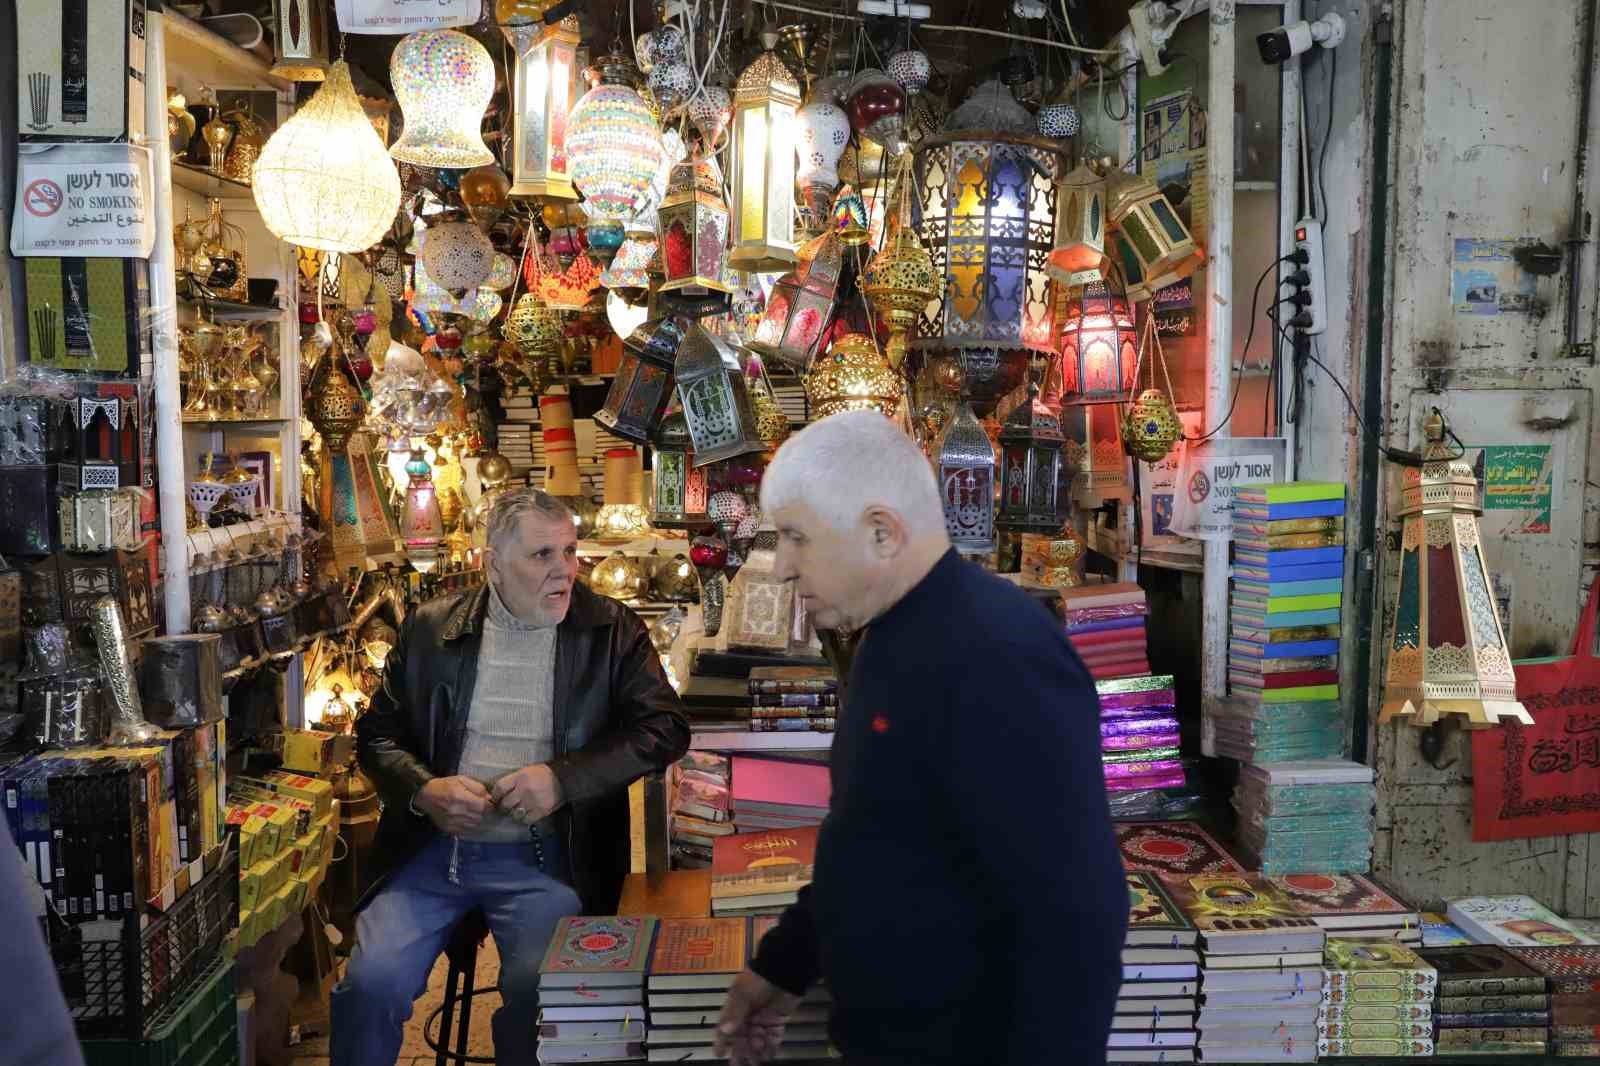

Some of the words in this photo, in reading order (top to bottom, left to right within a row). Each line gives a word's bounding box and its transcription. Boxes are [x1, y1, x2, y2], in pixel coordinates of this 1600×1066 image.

[66, 170, 101, 193] לעשן
[106, 173, 139, 189] אסור
[68, 196, 85, 209] NO
[1214, 461, 1241, 483] לעשן
[1243, 464, 1272, 478] אסור
[1214, 487, 1229, 498] NO
